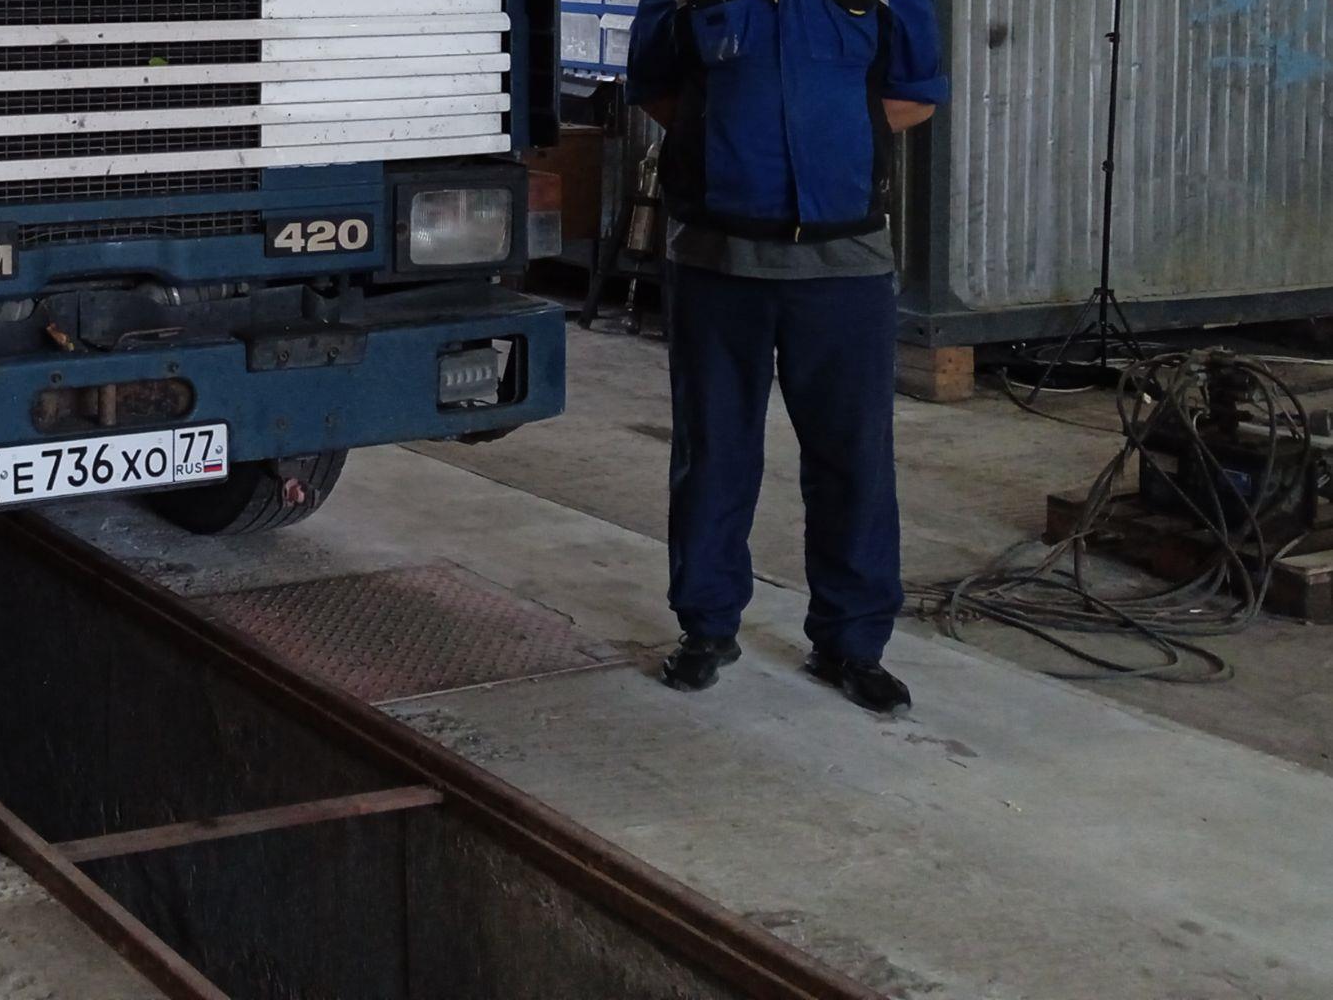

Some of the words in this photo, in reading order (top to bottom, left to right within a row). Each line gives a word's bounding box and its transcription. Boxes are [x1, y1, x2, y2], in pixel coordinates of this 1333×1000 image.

[274, 218, 369, 253] 420
[179, 430, 214, 463] 77
[176, 463, 203, 476] RUS
